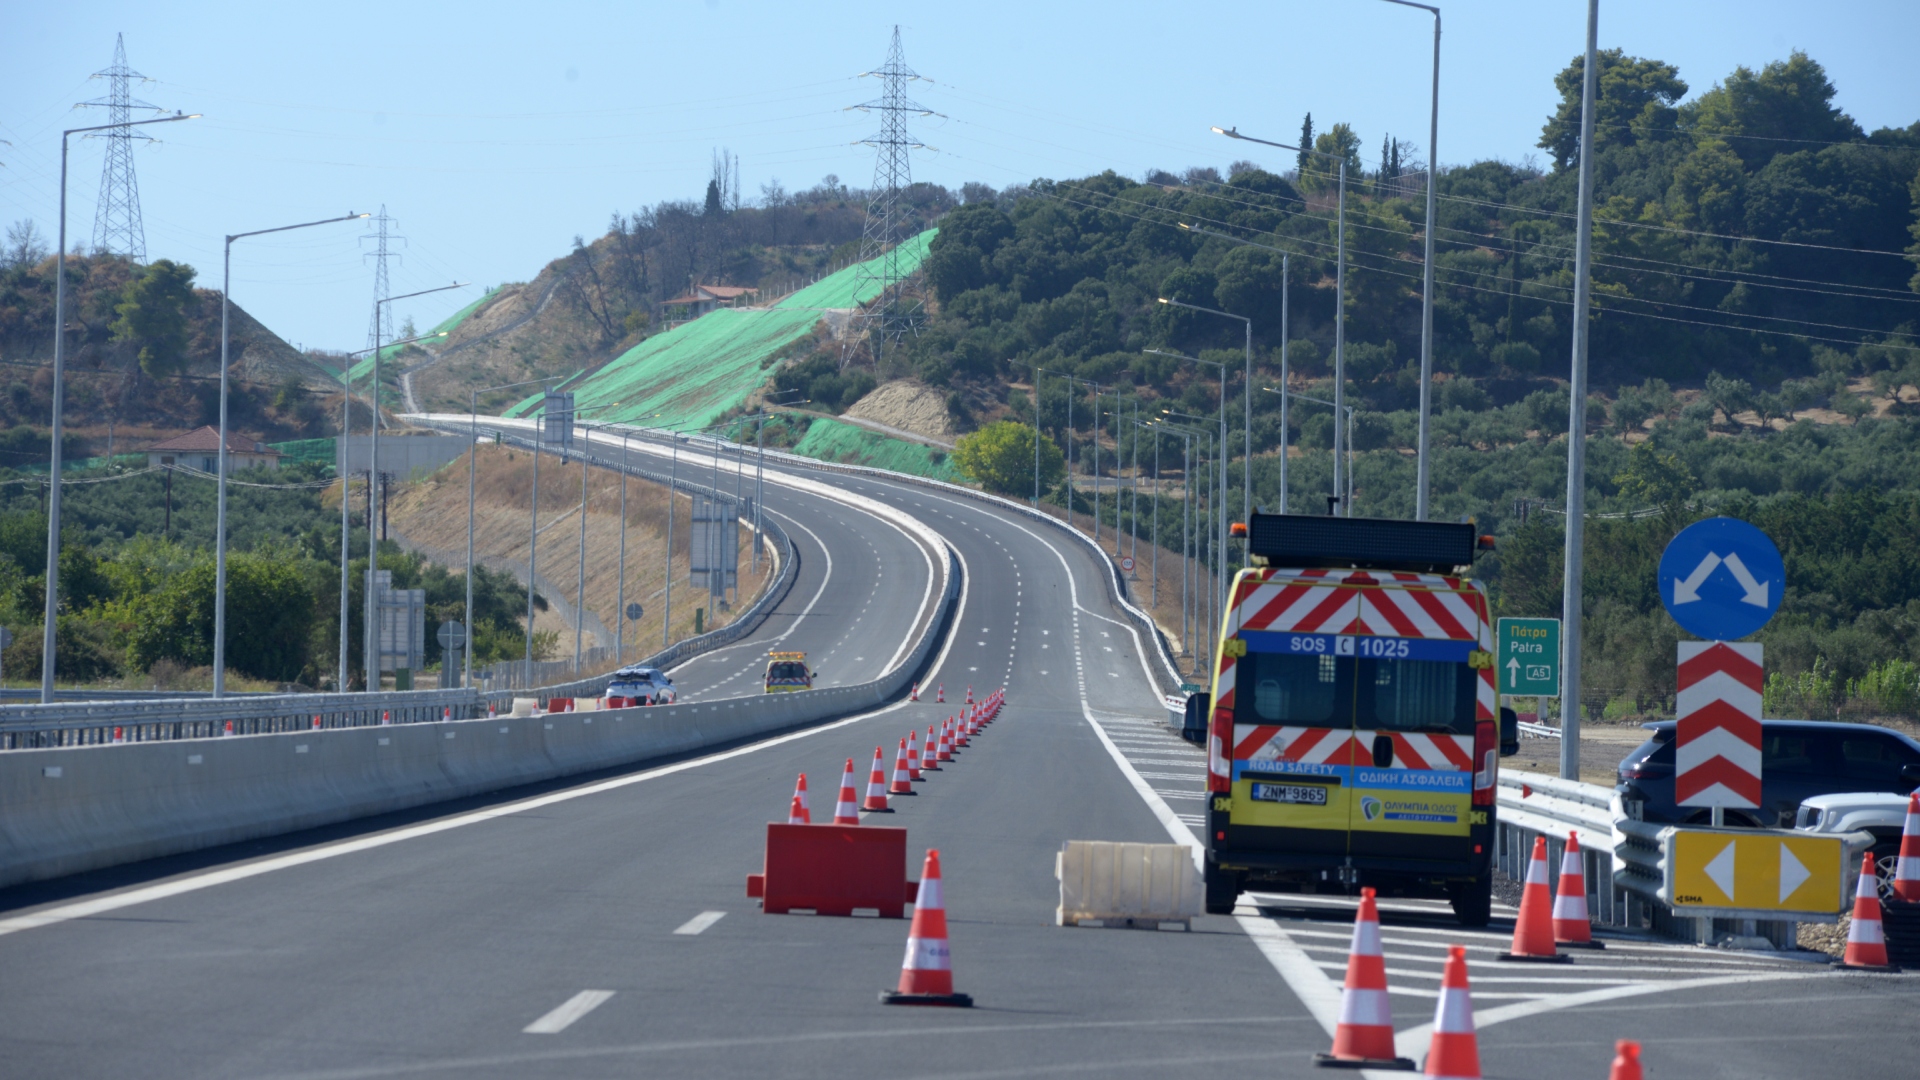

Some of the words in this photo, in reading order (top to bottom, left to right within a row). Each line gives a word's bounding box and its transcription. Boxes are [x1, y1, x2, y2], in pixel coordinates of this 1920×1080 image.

[1511, 625, 1547, 640] Πάτρα
[1290, 637, 1326, 652] SOS
[1360, 638, 1409, 657] 1025
[1511, 641, 1543, 653] Patra
[1532, 668, 1545, 678] A5
[1248, 761, 1284, 771] ROAD
[1287, 762, 1335, 774] SAFETY
[1360, 772, 1398, 784] ΟΔΙΚΗ
[1401, 774, 1464, 787] ΑΣΦΑΛΕΙΑ
[1263, 785, 1286, 799] ZNM
[1292, 787, 1324, 801] 9865
[1384, 801, 1429, 811] ΟΛΥΜΠΙΑ
[1431, 804, 1457, 814] ΟΔΟΣ
[1398, 814, 1442, 822] ΛΕΙΤΟΥΡΓΙΑ
[1684, 895, 1703, 903] SMA
